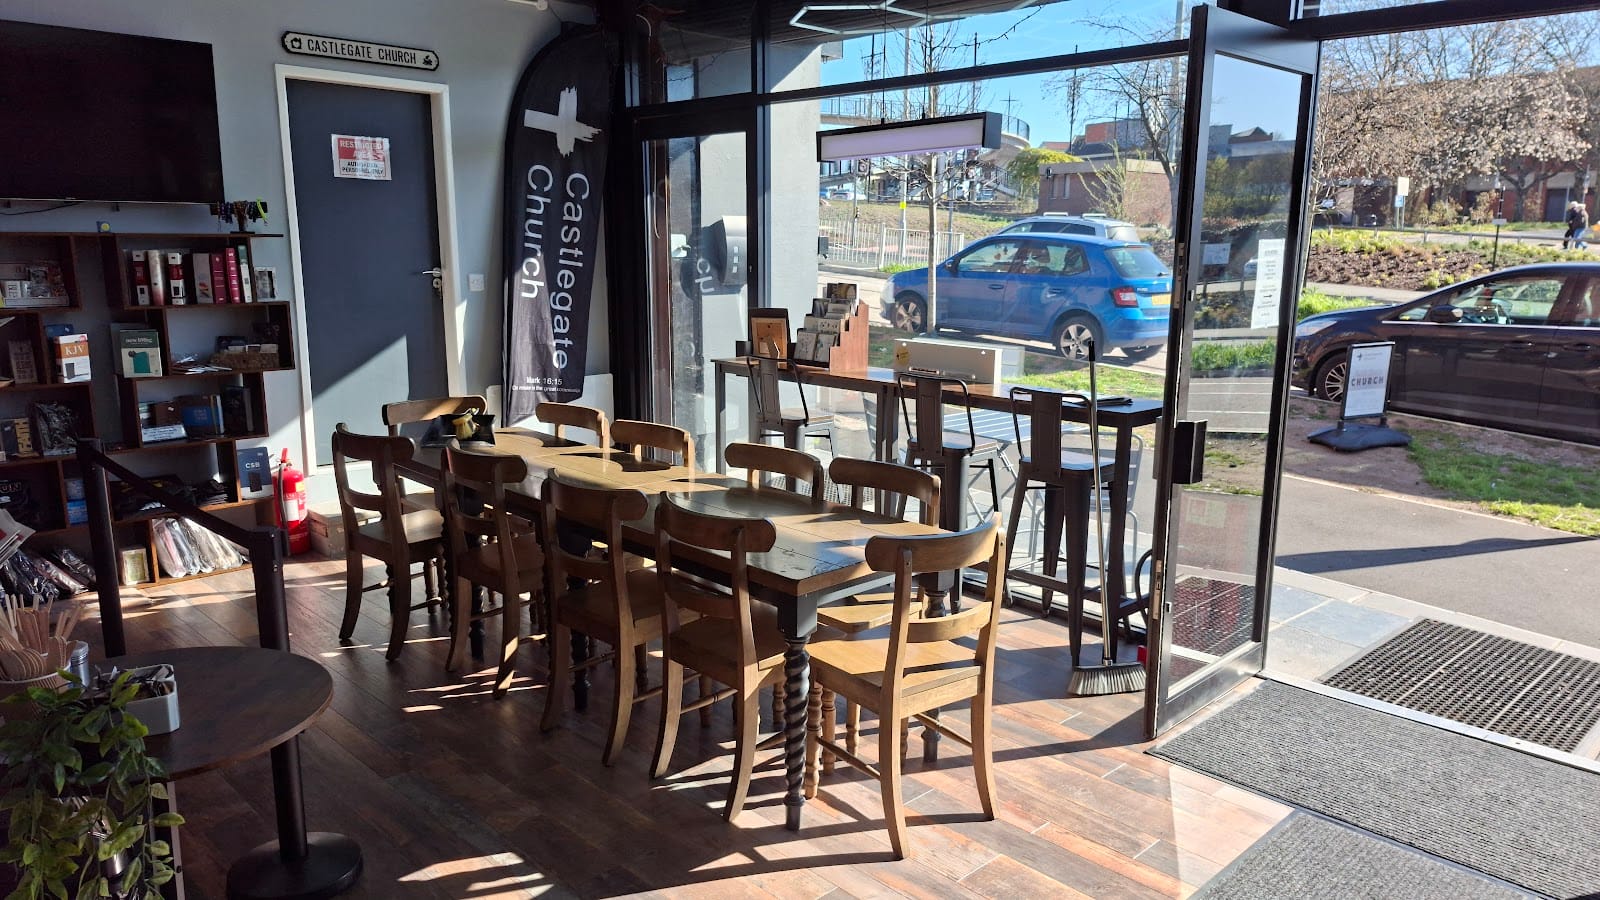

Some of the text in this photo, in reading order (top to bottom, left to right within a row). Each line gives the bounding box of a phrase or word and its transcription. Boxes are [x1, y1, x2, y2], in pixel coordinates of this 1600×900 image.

[307, 39, 417, 64] CASTLEGATE CHURCH
[520, 164, 554, 299] Church
[550, 172, 590, 370] Castlegate
[65, 345, 85, 356] KJV
[526, 376, 563, 385] Mark 16:15
[1350, 375, 1385, 387] CHURCH
